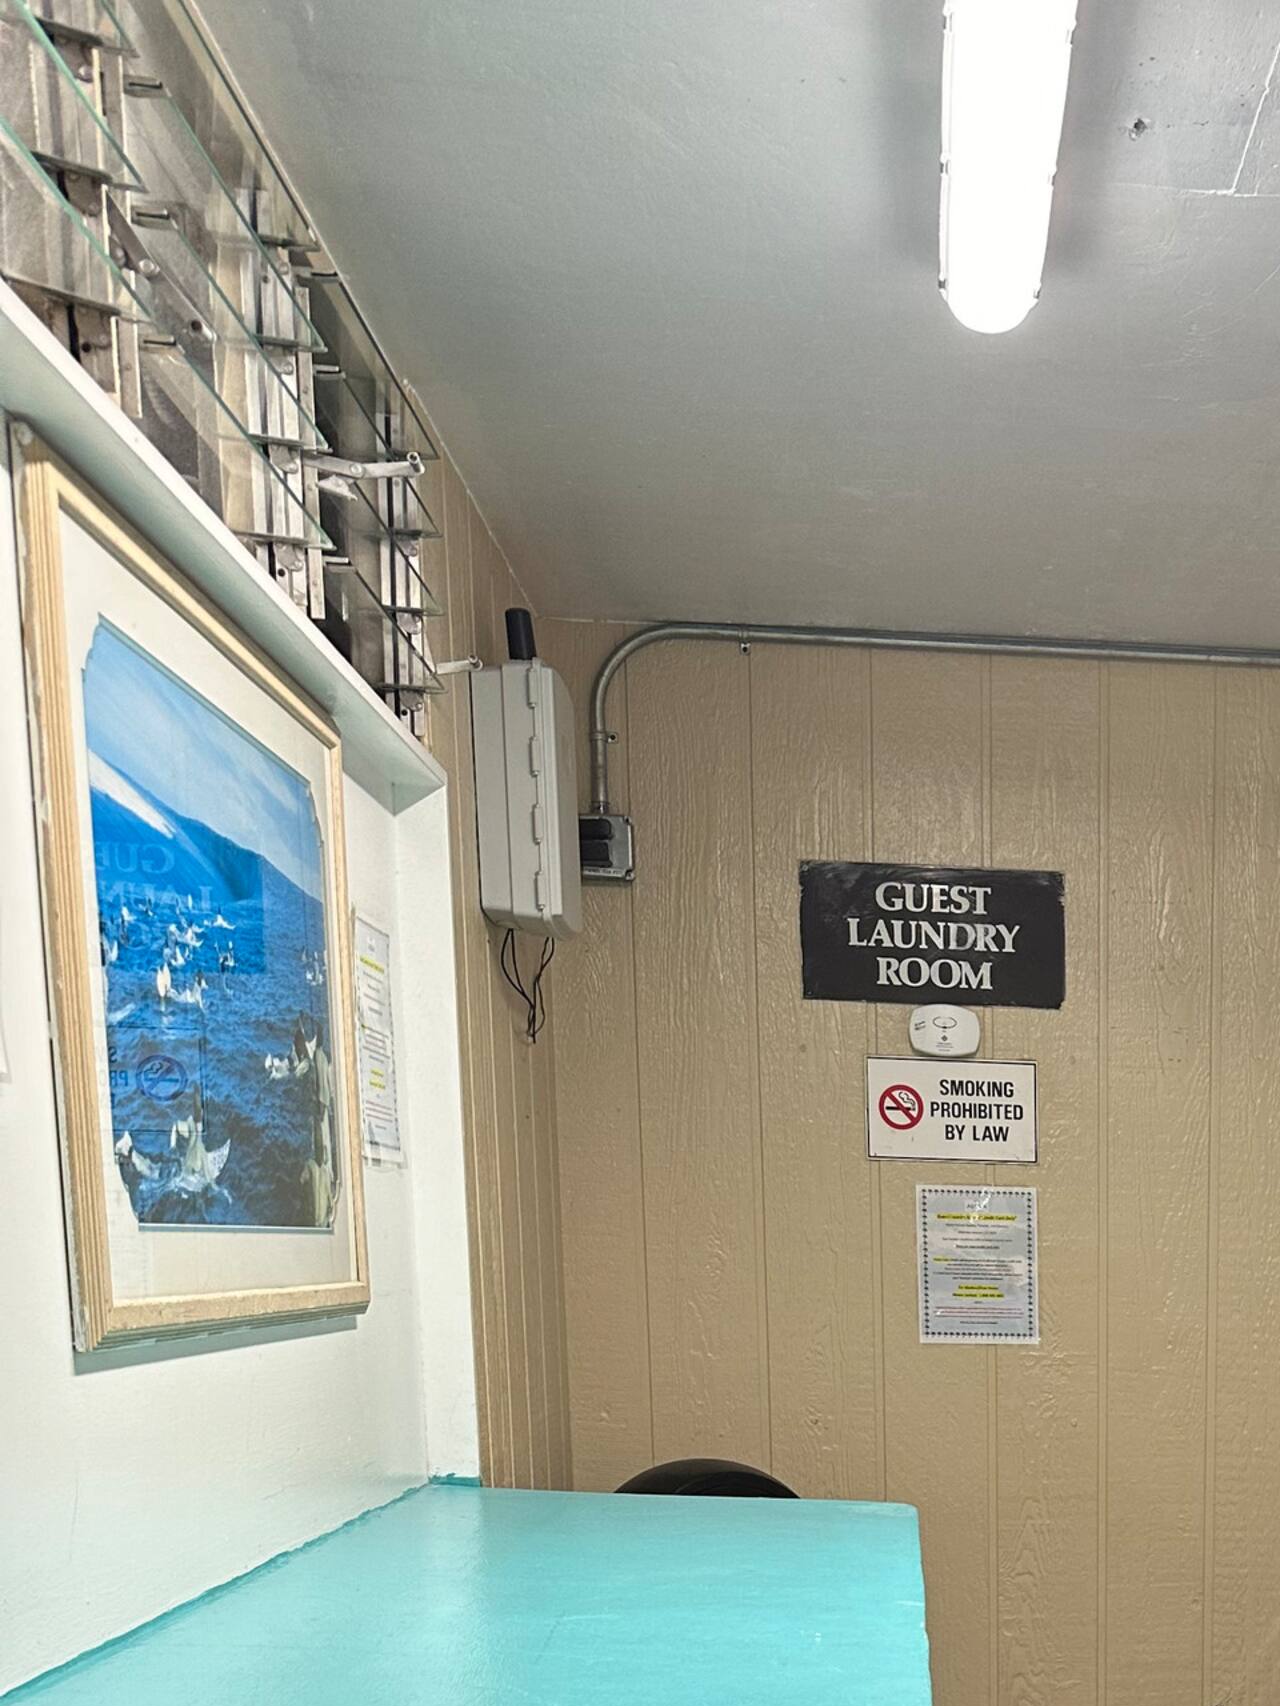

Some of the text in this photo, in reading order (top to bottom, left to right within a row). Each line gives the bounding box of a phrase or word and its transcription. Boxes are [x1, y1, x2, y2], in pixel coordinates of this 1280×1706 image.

[875, 882, 991, 914] GUEST
[847, 918, 1020, 952] LAUNDRY
[876, 957, 993, 990] ROOM
[939, 1079, 1015, 1098] SMOKING
[930, 1101, 1024, 1121] PROHIBITED
[944, 1124, 1010, 1143] BY LAW
